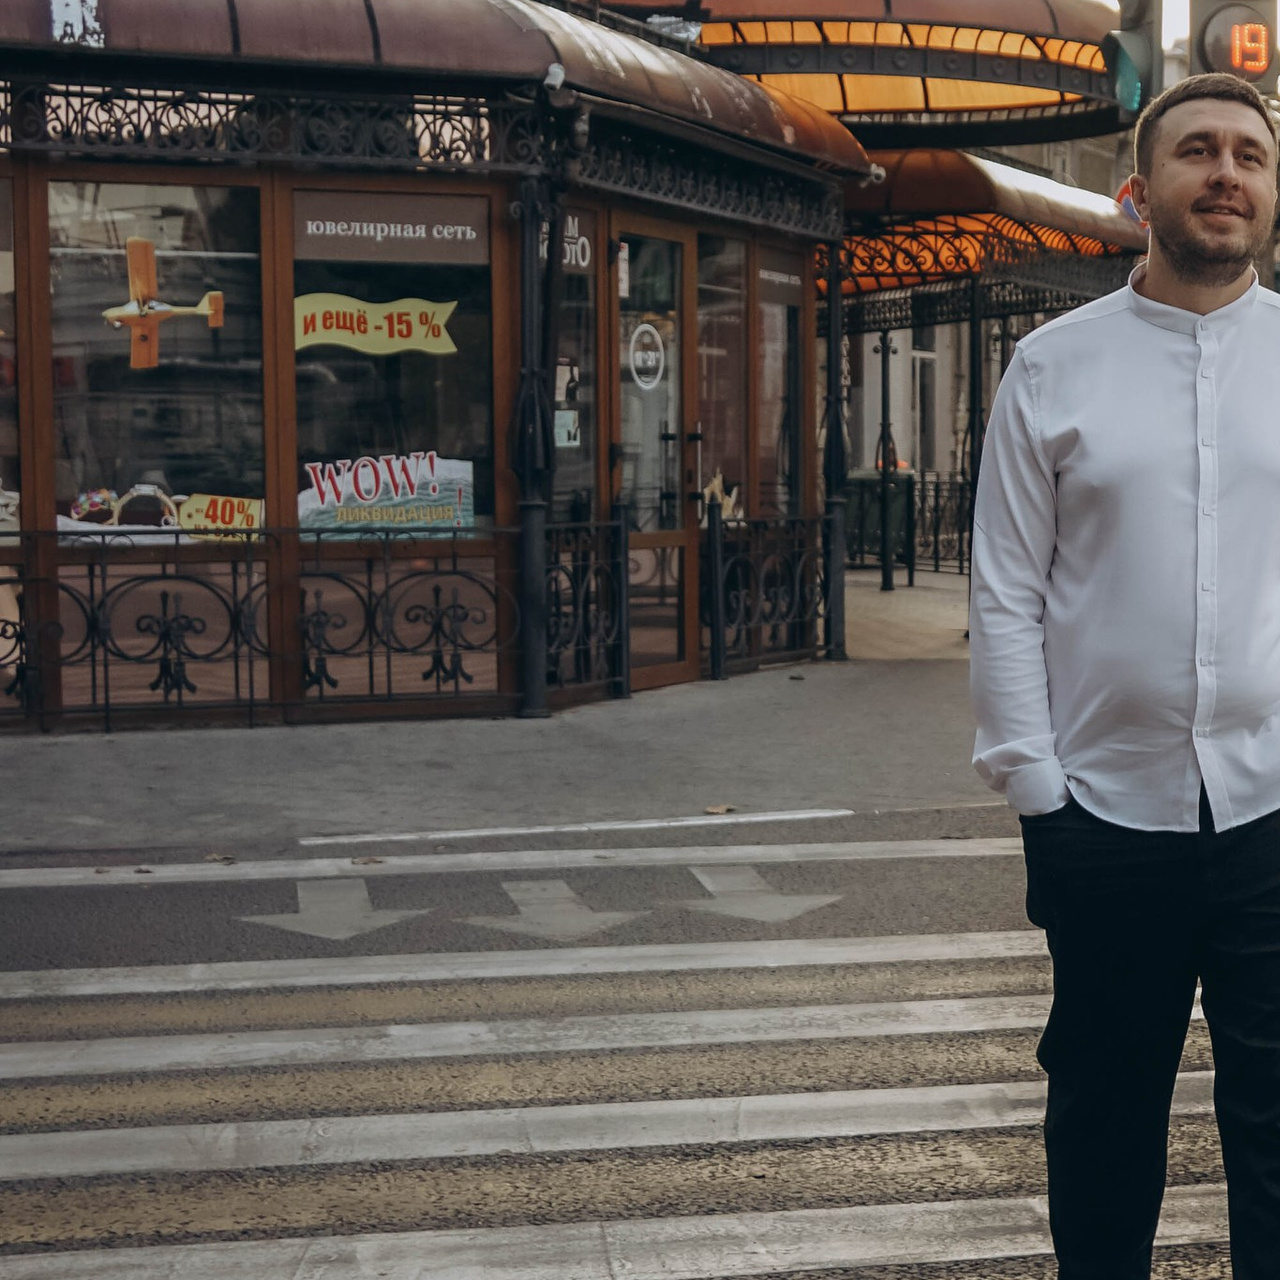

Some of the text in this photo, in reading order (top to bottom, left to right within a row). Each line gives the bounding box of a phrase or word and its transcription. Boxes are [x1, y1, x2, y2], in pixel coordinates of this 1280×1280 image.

[1231, 23, 1269, 73] 19
[306, 221, 477, 242] ювелирная сеть
[322, 309, 368, 335] ещё
[306, 452, 440, 505] WOW!
